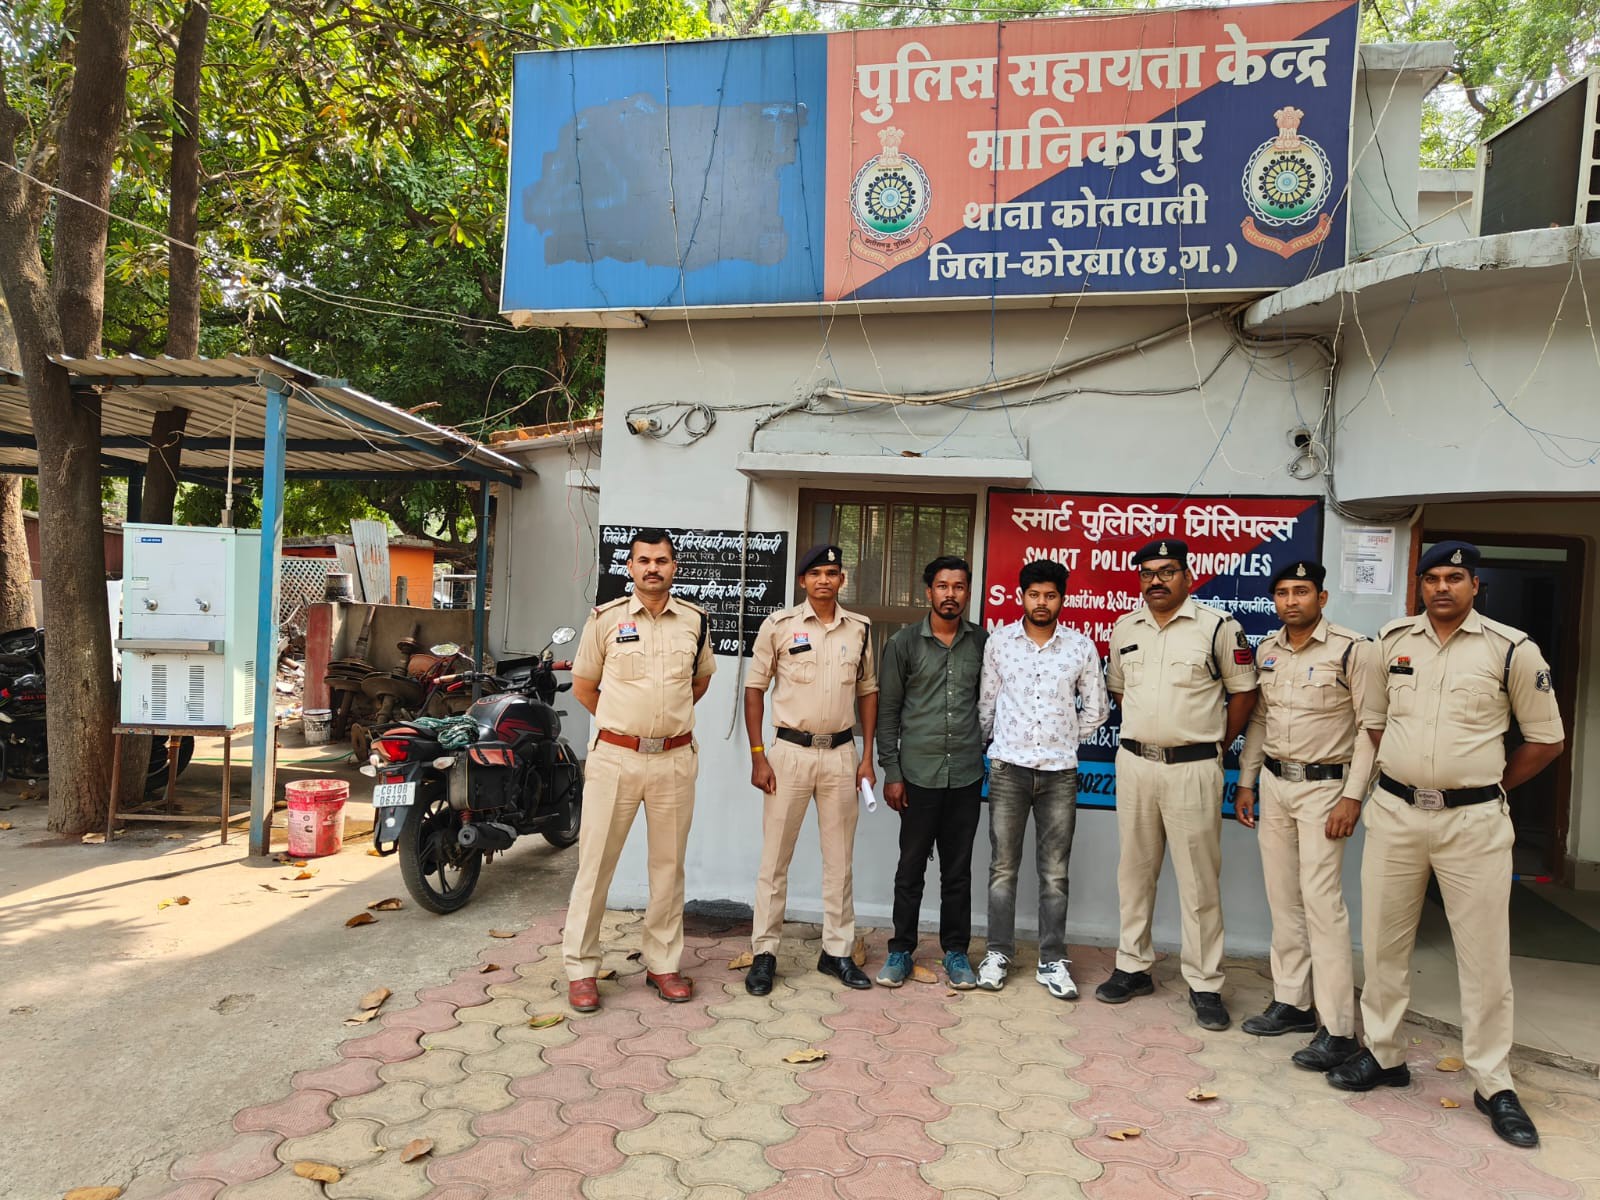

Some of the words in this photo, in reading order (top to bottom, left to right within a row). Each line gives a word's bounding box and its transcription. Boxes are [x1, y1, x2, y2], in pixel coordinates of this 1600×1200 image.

[856, 42, 998, 124] पुलिस
[1008, 46, 1206, 103] सहायता
[1215, 24, 1330, 88] केन्द्र
[967, 108, 1206, 185] मानिकपुर
[963, 201, 1045, 231] थाना
[1051, 183, 1208, 228] कोतवाली
[1011, 500, 1074, 532] स्मार्ट
[1079, 503, 1178, 542] पुलिसिंग
[1183, 504, 1298, 542] प्रिंसिपल्स
[1186, 552, 1272, 580] RINCIPLES
